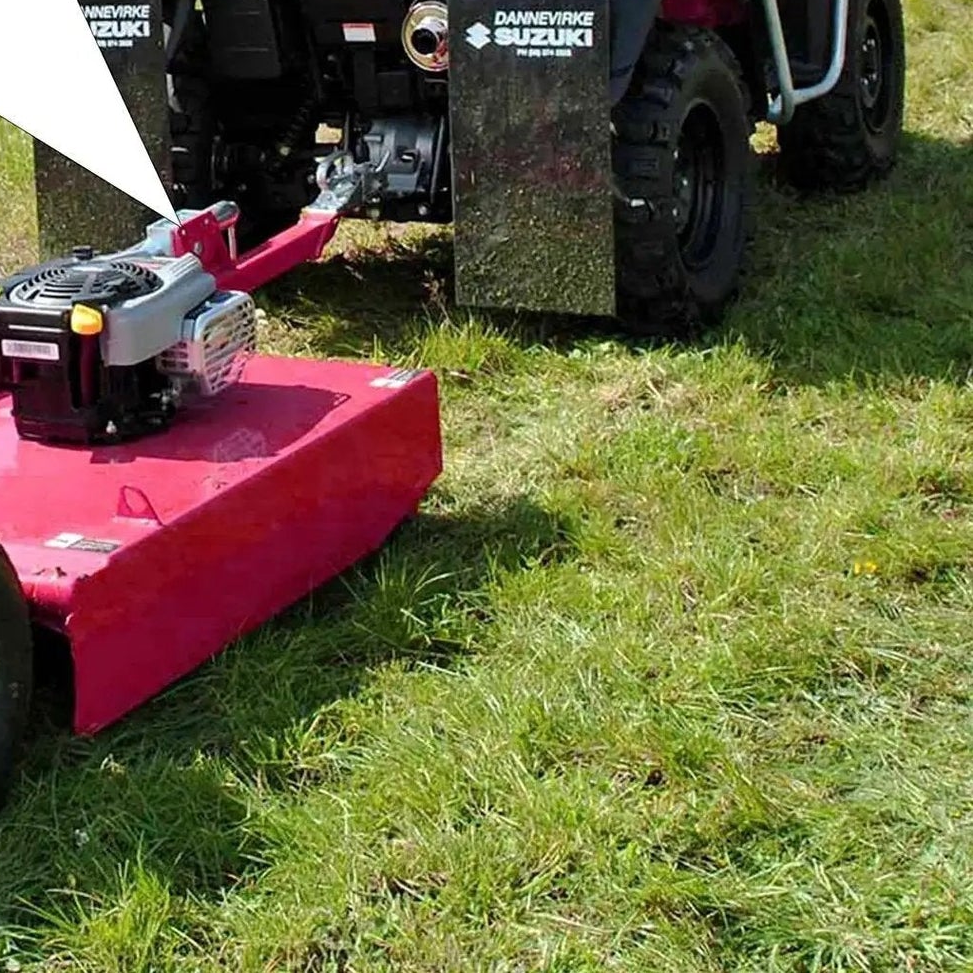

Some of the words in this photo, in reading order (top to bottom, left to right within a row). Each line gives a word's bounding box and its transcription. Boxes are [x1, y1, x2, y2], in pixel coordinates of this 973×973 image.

[81, 5, 151, 18] NNEVIRKE
[494, 11, 595, 26] DANNEVIRKE
[90, 21, 150, 38] ZUKI
[494, 27, 593, 47] SUZUKI
